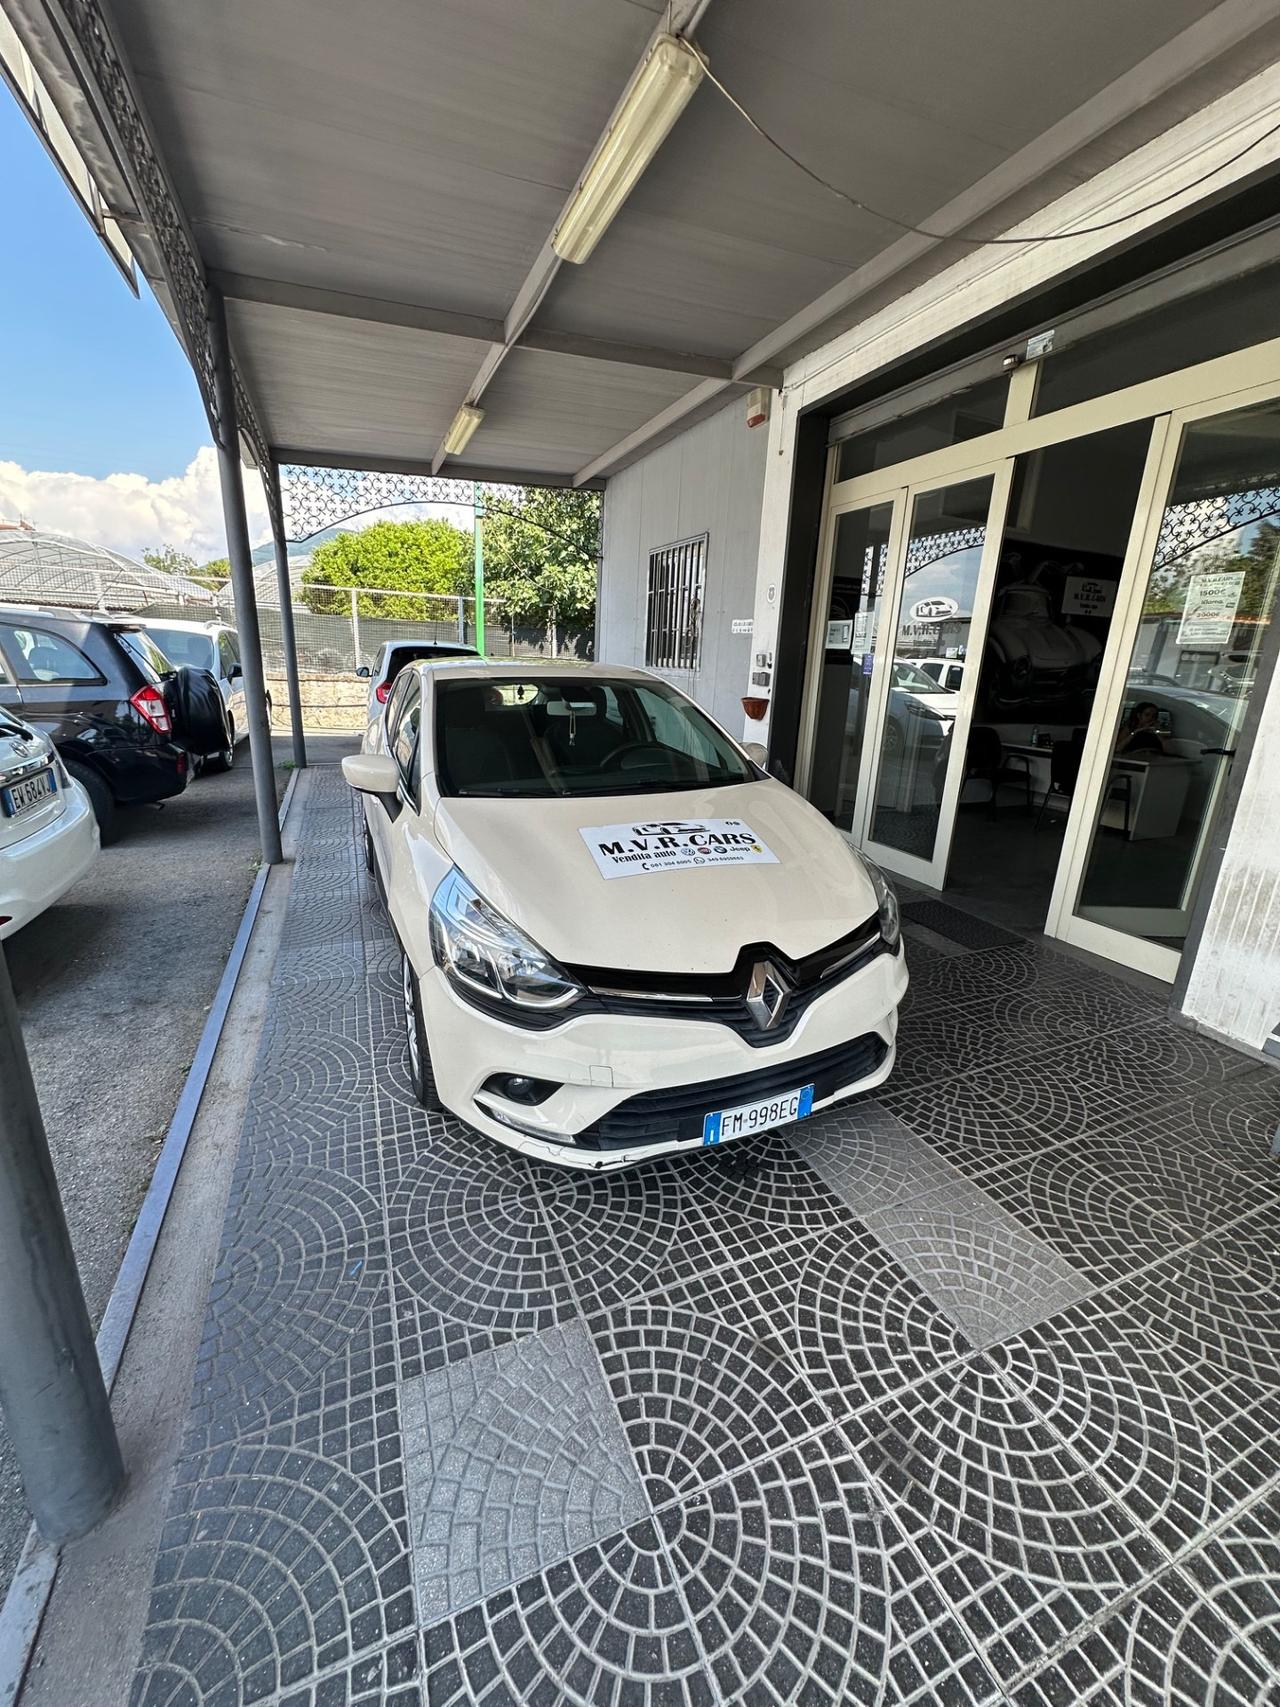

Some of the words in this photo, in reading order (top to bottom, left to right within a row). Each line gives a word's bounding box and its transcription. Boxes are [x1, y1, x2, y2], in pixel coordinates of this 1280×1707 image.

[598, 832, 756, 857] M.V.R.CARS
[611, 852, 652, 864] Vendita
[653, 850, 677, 860] auto
